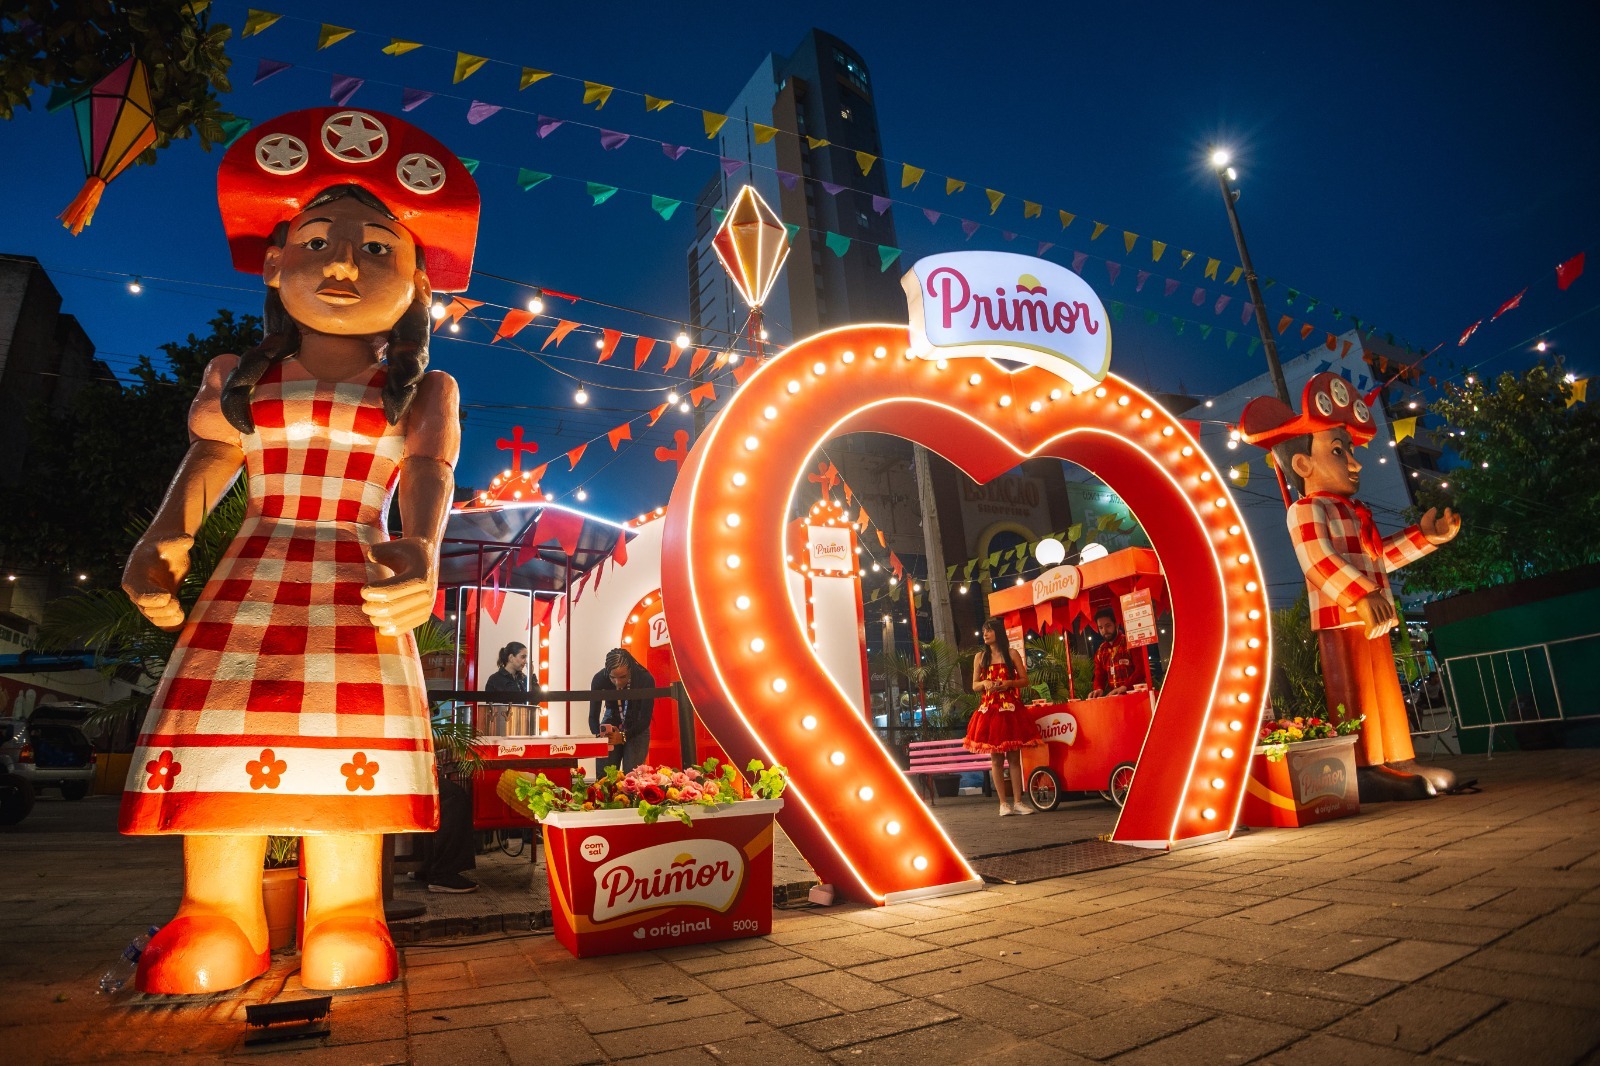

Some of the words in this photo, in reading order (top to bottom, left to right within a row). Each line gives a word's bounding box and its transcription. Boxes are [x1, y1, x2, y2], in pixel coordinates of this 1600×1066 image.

[927, 267, 1099, 335] Primor
[816, 544, 845, 555] Primor
[1035, 575, 1075, 599] Primor
[500, 745, 523, 754] Primor
[551, 744, 574, 753] Primor
[1302, 769, 1344, 796] Primor
[589, 848, 602, 856] sal
[602, 858, 735, 908] Primor
[650, 917, 711, 938] original
[733, 919, 758, 931] 500g
